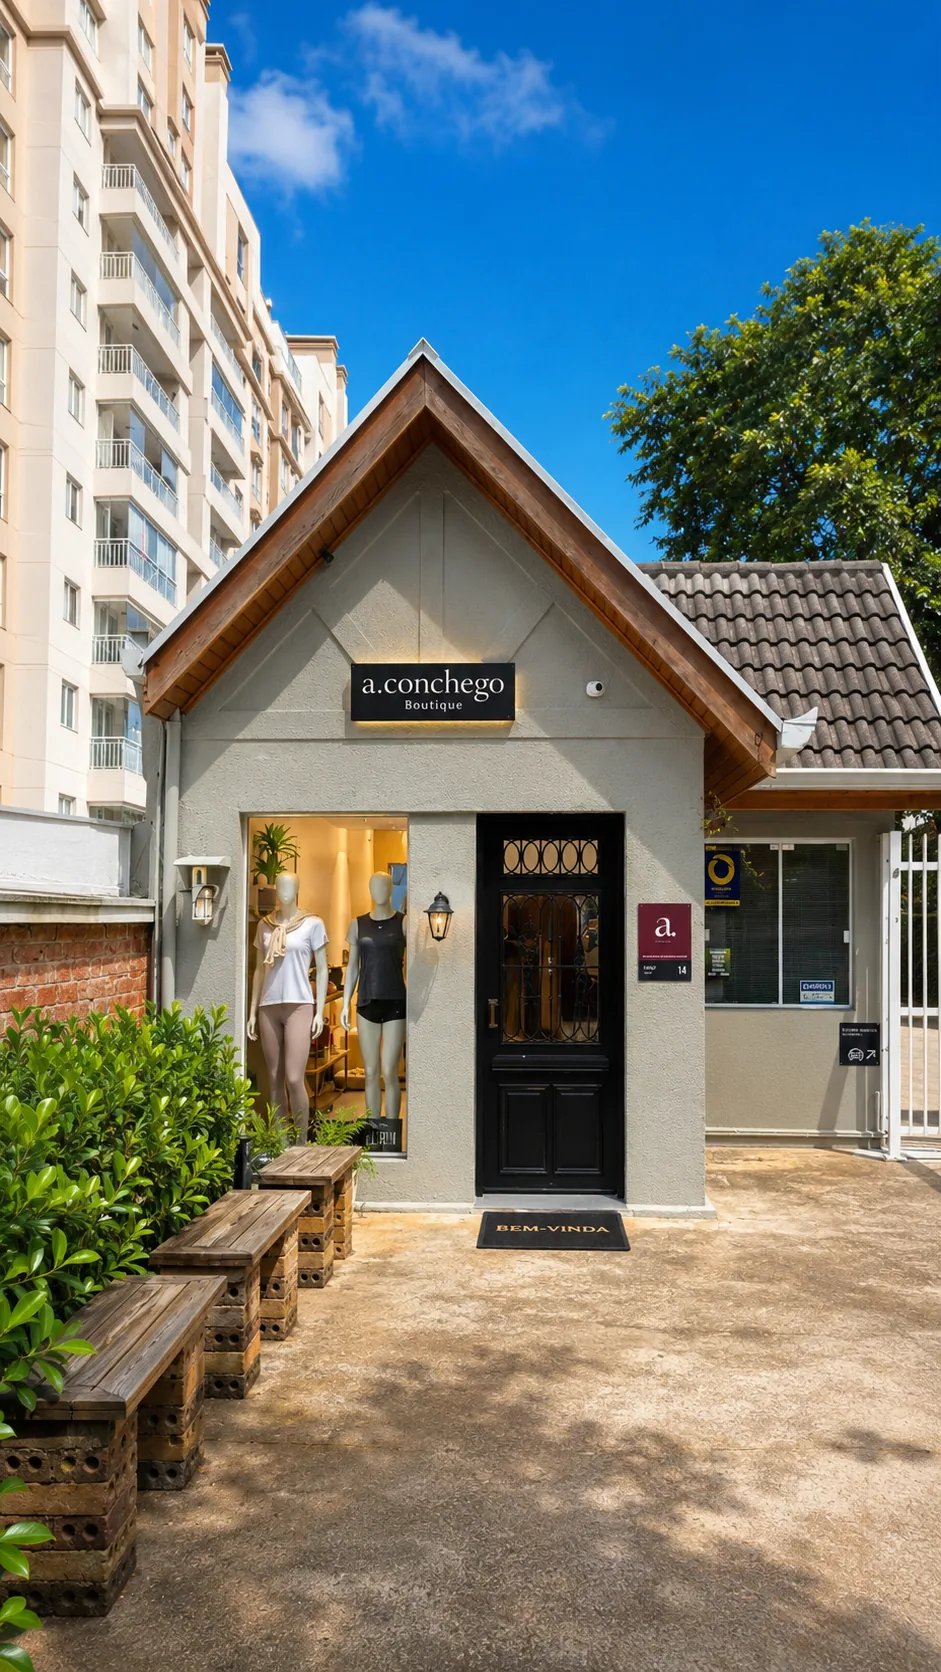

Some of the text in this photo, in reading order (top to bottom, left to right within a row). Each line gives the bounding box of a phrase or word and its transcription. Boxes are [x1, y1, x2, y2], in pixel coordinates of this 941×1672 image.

[362, 669, 504, 702] a.conchego
[405, 700, 462, 712] Boutique
[655, 917, 676, 937] a.
[678, 965, 687, 975] 14
[496, 1225, 609, 1233] BEM-VINDA
